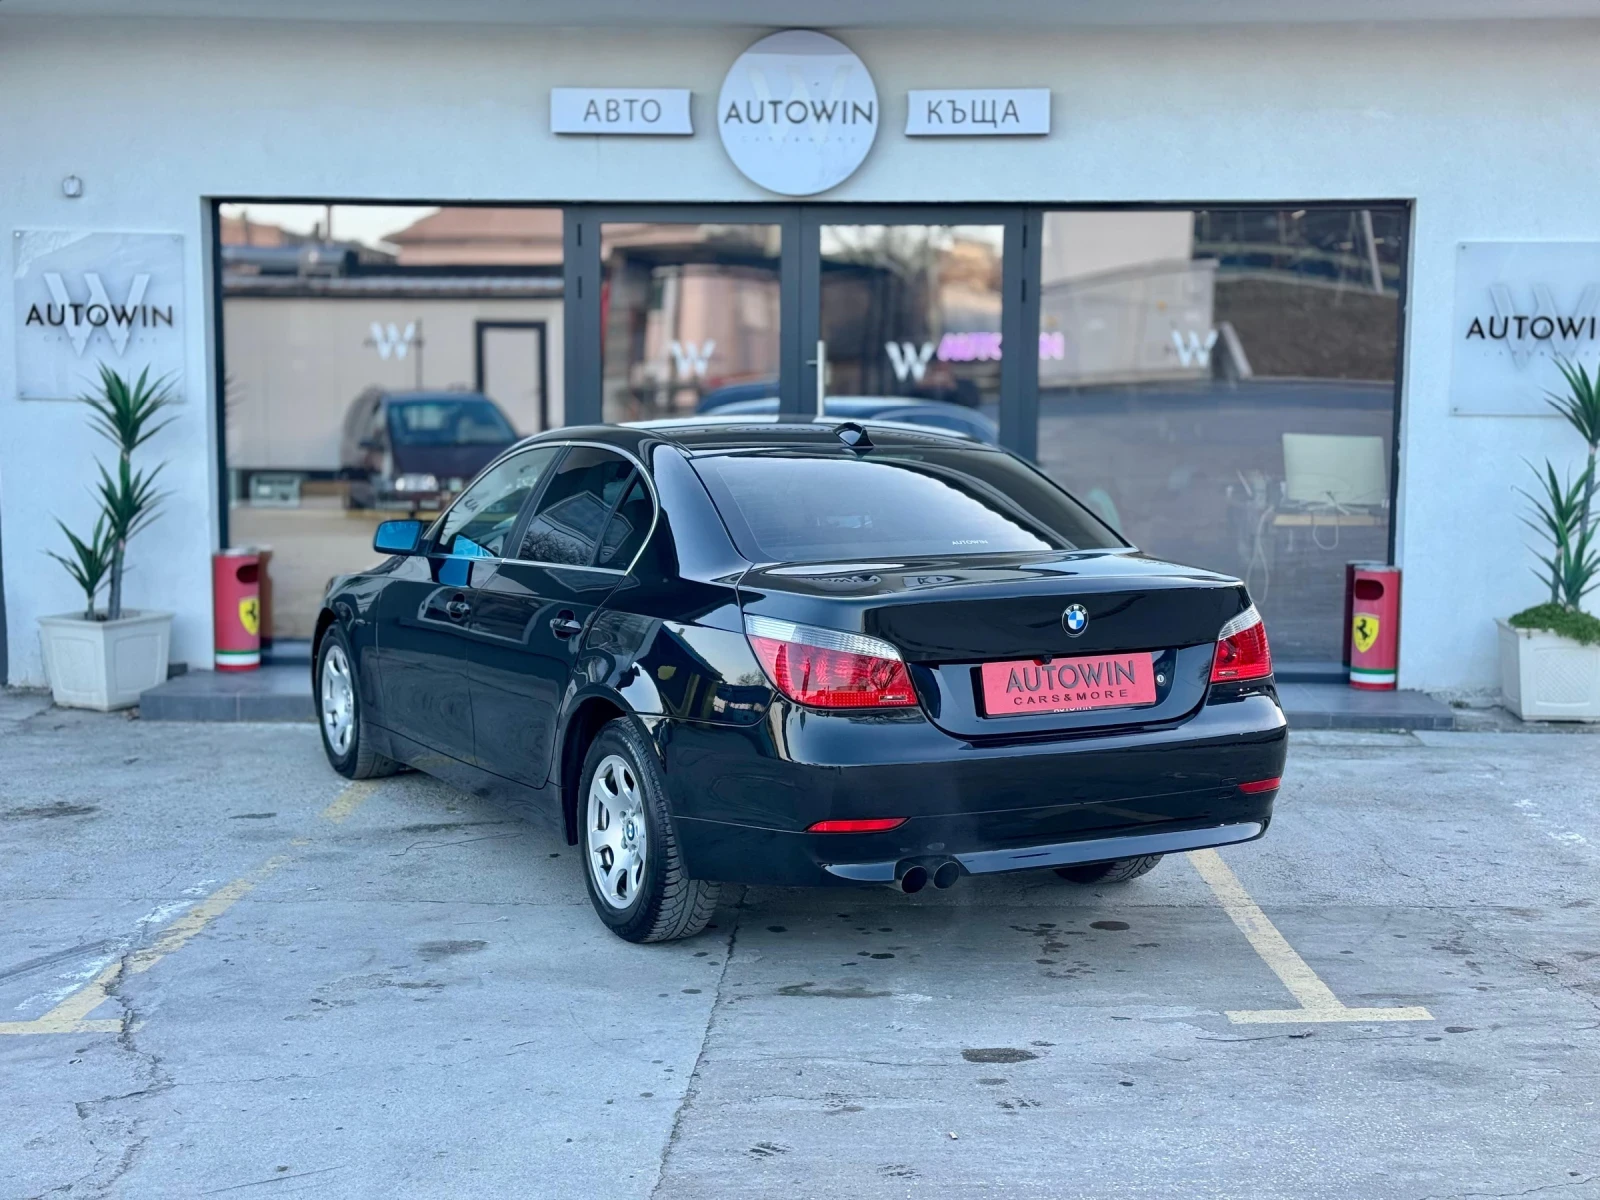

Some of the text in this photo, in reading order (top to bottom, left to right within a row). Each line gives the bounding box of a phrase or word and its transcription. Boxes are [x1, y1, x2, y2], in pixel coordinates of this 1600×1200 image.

[583, 98, 662, 123] АВТО
[724, 99, 873, 125] AUTOWIN
[927, 98, 1020, 129] КЪЩА
[25, 303, 173, 329] AUTOWIN
[1465, 315, 1597, 341] AUTOWI
[885, 340, 936, 382] W
[1006, 659, 1136, 694] AUTOWIN
[1013, 689, 1129, 706] CARS&MORE
